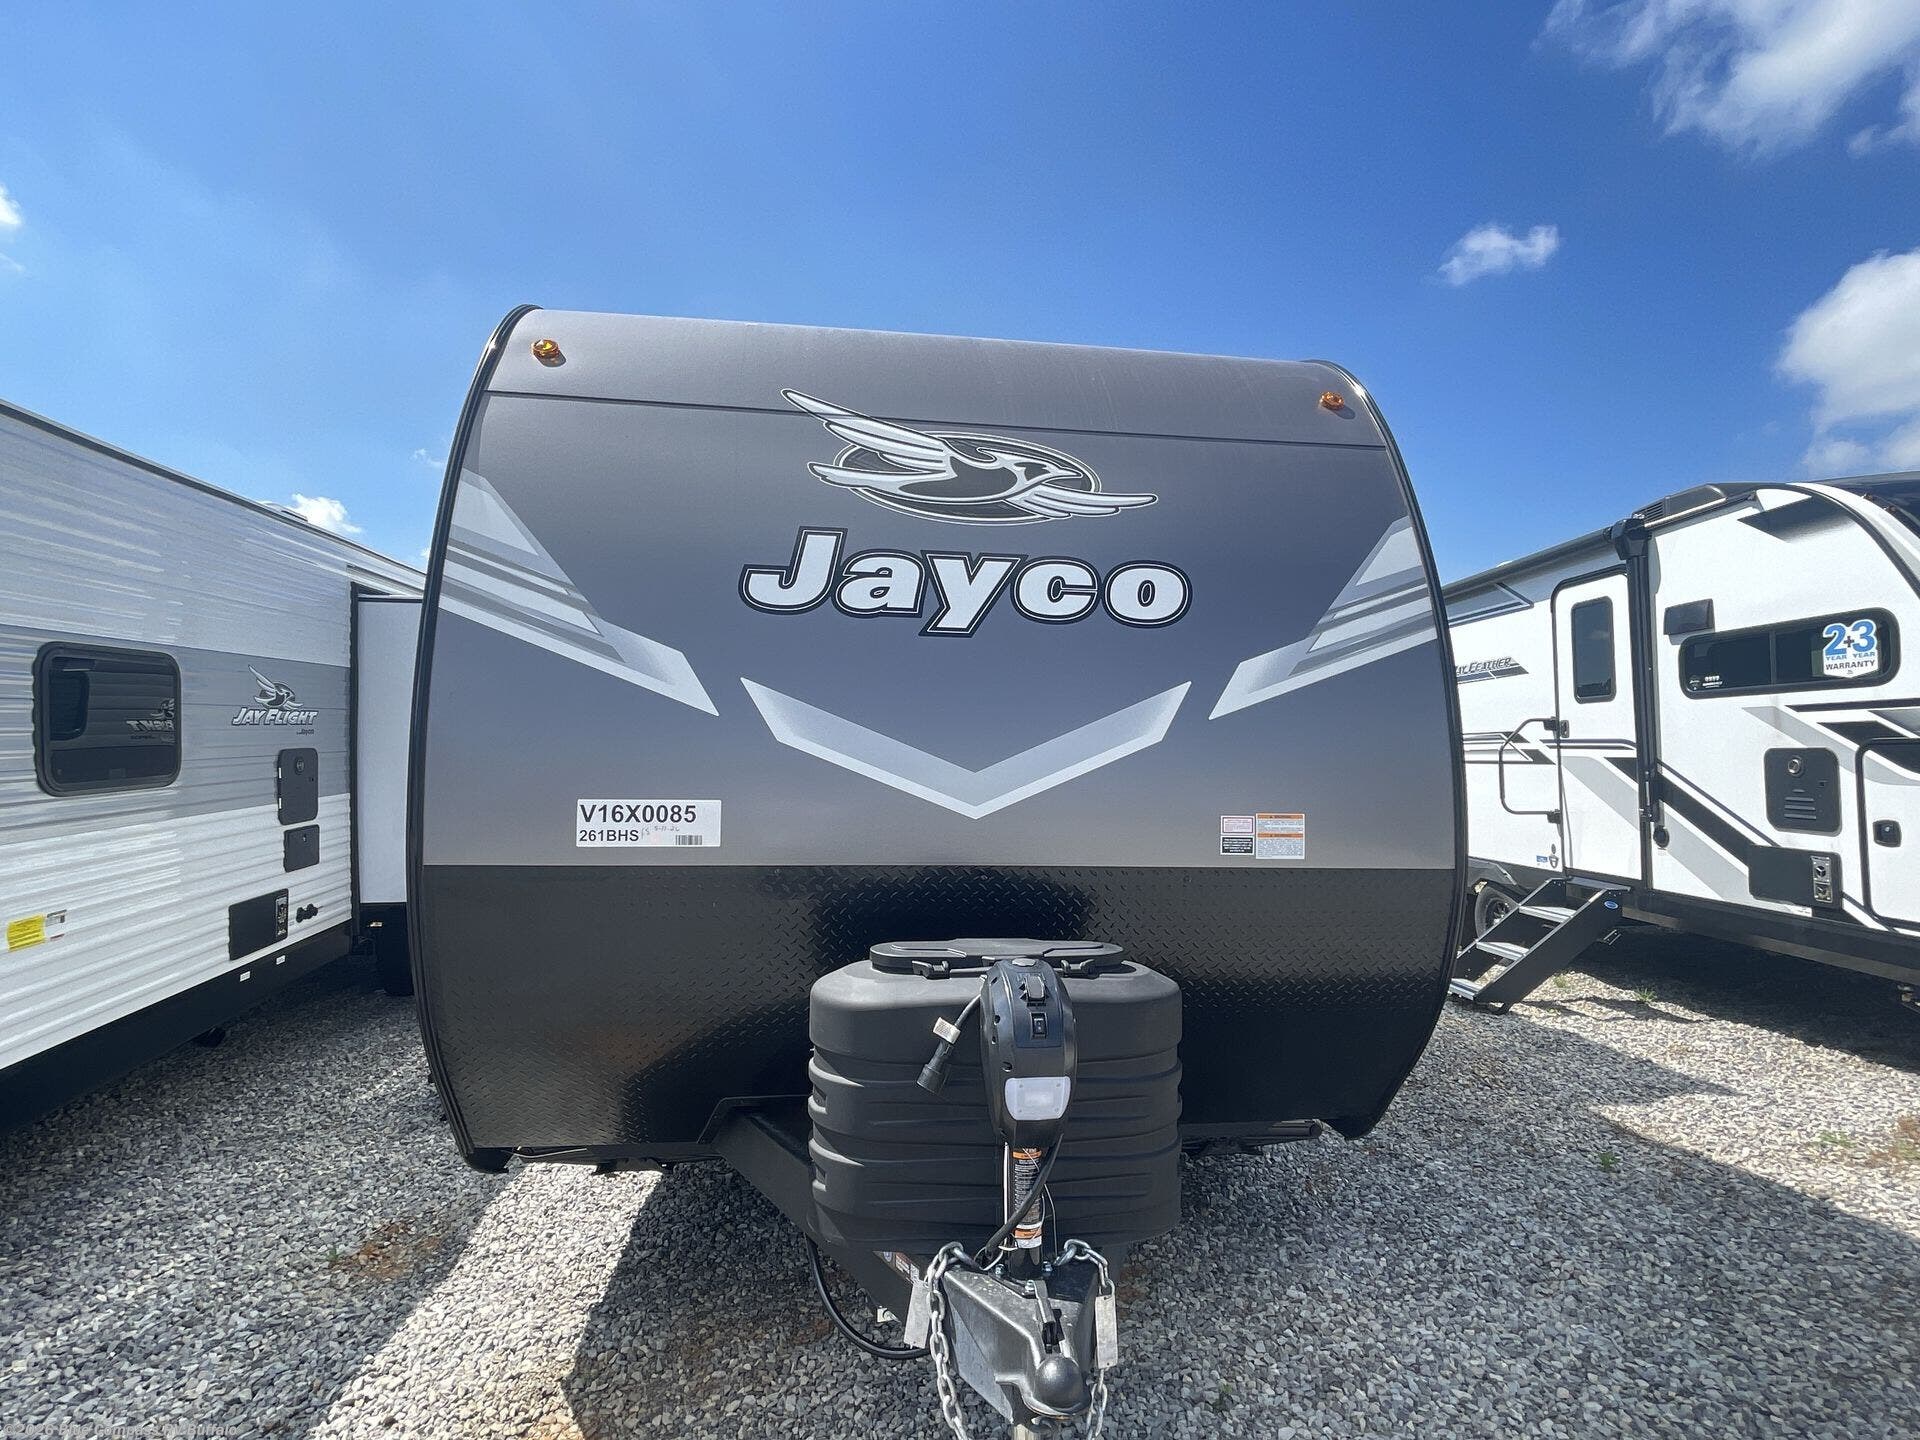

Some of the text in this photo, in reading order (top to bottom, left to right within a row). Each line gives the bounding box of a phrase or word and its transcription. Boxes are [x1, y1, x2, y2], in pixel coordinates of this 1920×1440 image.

[738, 525, 1193, 637] Jayco
[1469, 656, 1511, 673] FEATHER
[1825, 660, 1875, 670] WARRANTY
[232, 707, 318, 726] JAY FLIGHT
[580, 804, 697, 823] V16X0085
[579, 829, 639, 842] 261BHS
